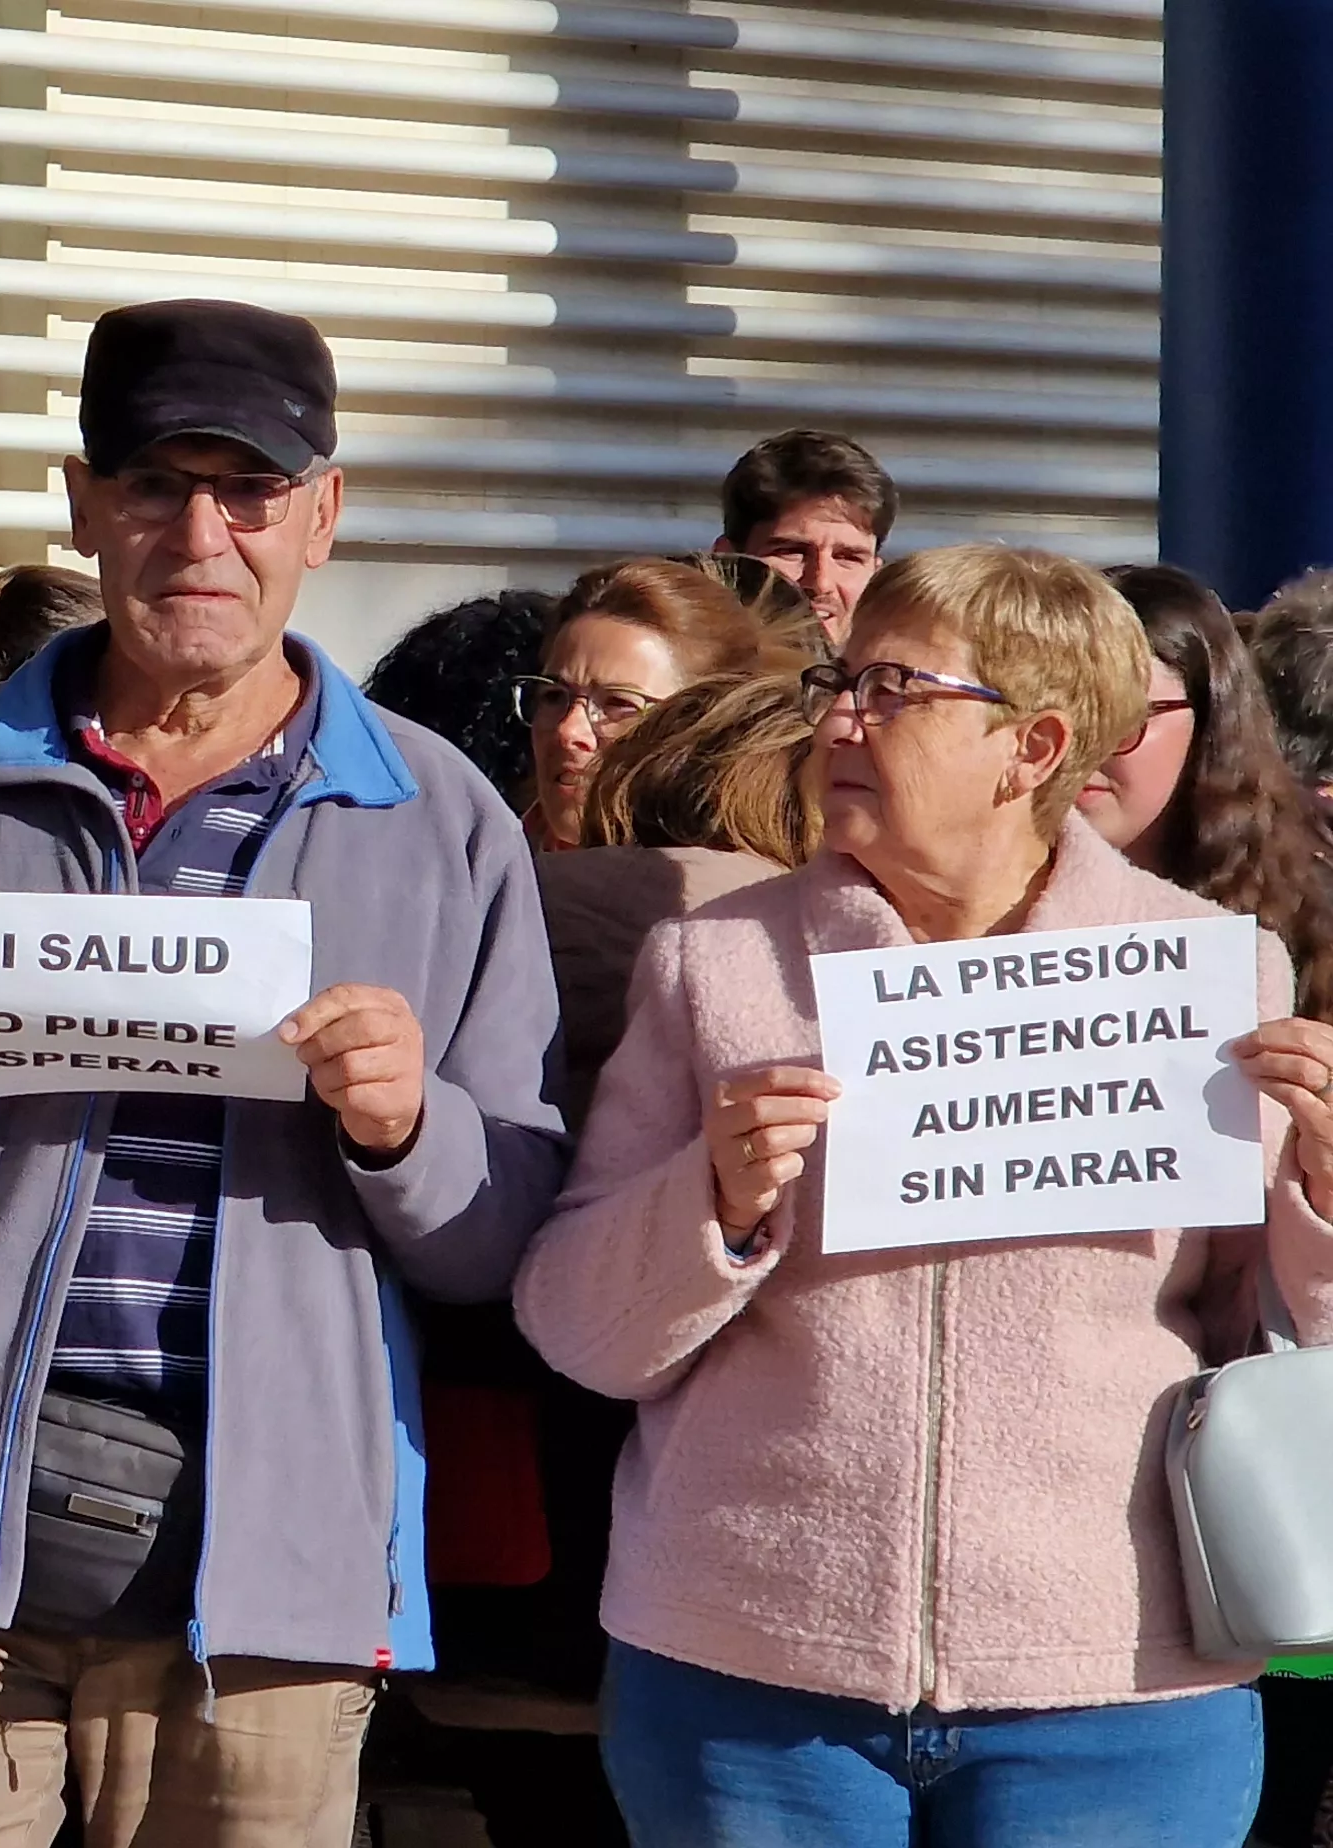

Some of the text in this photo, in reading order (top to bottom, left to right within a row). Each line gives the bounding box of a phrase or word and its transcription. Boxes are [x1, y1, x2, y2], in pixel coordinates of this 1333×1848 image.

[38, 933, 230, 975] SALUD
[872, 932, 1189, 1004] LA PRESIÓN
[45, 1014, 238, 1048] PUEDE
[865, 1004, 1210, 1077] ASISTENCIAL
[911, 1077, 1165, 1139] AUMENTA
[899, 1145, 1181, 1206] SIN PARAR
